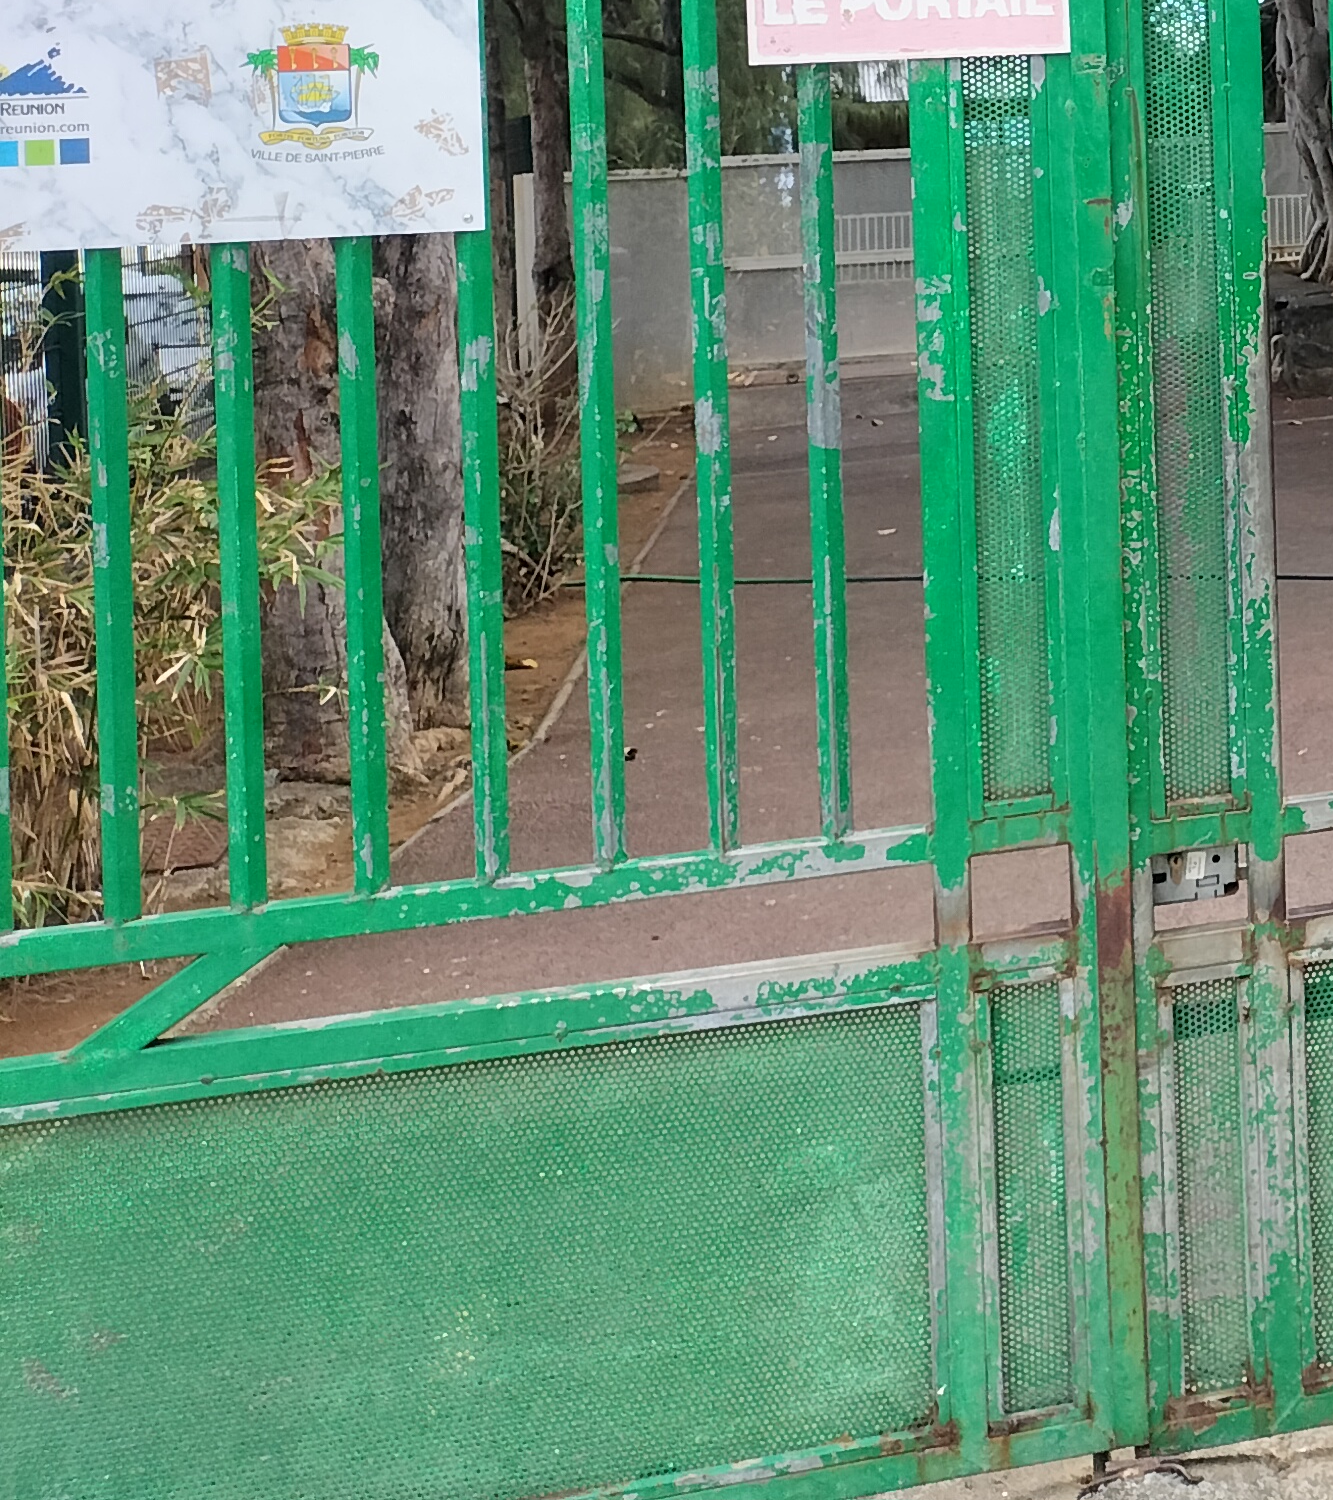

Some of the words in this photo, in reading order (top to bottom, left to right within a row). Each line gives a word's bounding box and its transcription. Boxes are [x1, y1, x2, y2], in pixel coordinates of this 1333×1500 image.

[250, 148, 283, 162] VILLE
[285, 152, 302, 163] DE
[304, 145, 385, 163] SAINT-PIERRE
